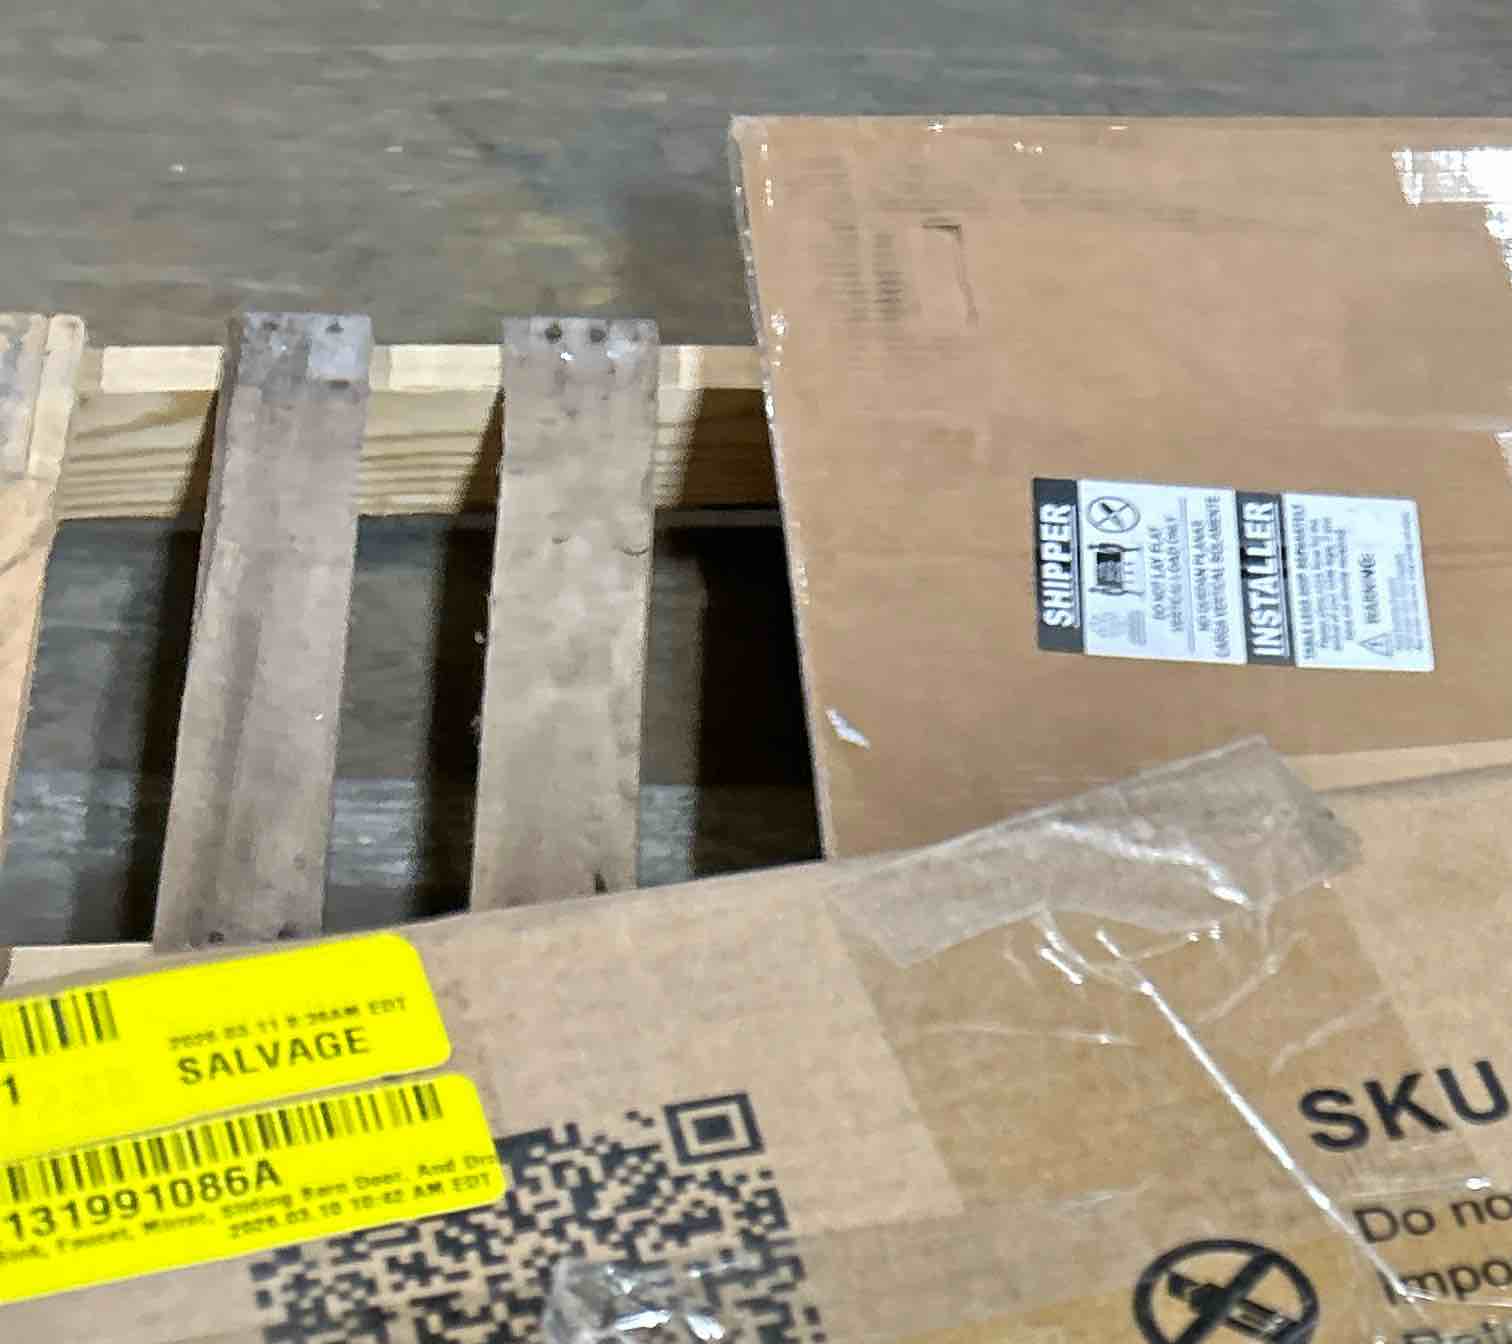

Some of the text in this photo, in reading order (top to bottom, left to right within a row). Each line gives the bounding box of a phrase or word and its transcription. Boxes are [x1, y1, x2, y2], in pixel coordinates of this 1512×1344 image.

[1040, 503, 1076, 627] SHIPPER
[1241, 502, 1284, 656] INSTALLER
[177, 1026, 370, 1085] SALVAGE
[7, 1159, 282, 1241] 131991086A
[1355, 1206, 1436, 1243] Do
